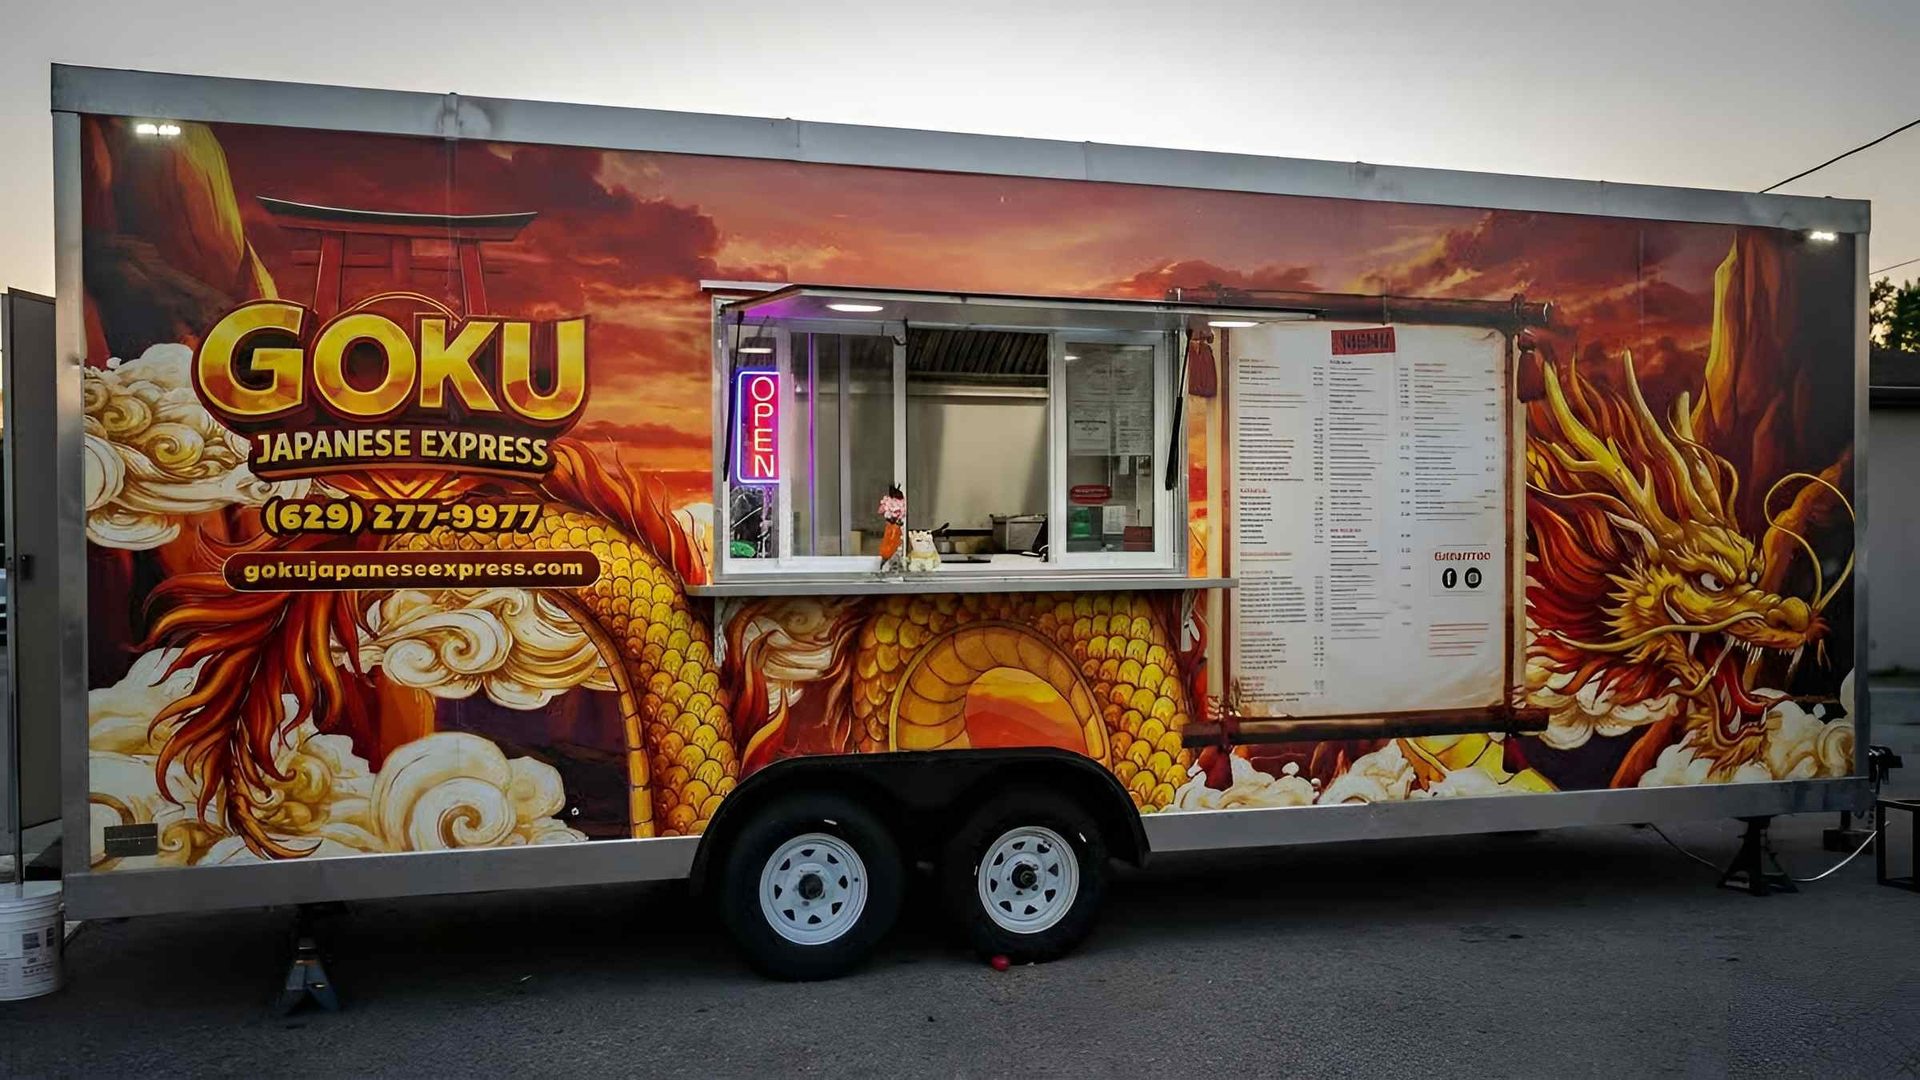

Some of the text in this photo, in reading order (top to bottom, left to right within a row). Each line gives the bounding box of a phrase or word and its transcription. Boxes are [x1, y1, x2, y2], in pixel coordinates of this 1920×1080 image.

[198, 302, 586, 421] GOKU
[751, 376, 775, 478] OPEN
[256, 429, 549, 467] JAPANESE EXPRESS
[265, 500, 540, 534] (629) 277-9977
[243, 560, 584, 583] gokujapaneseexpress.com
